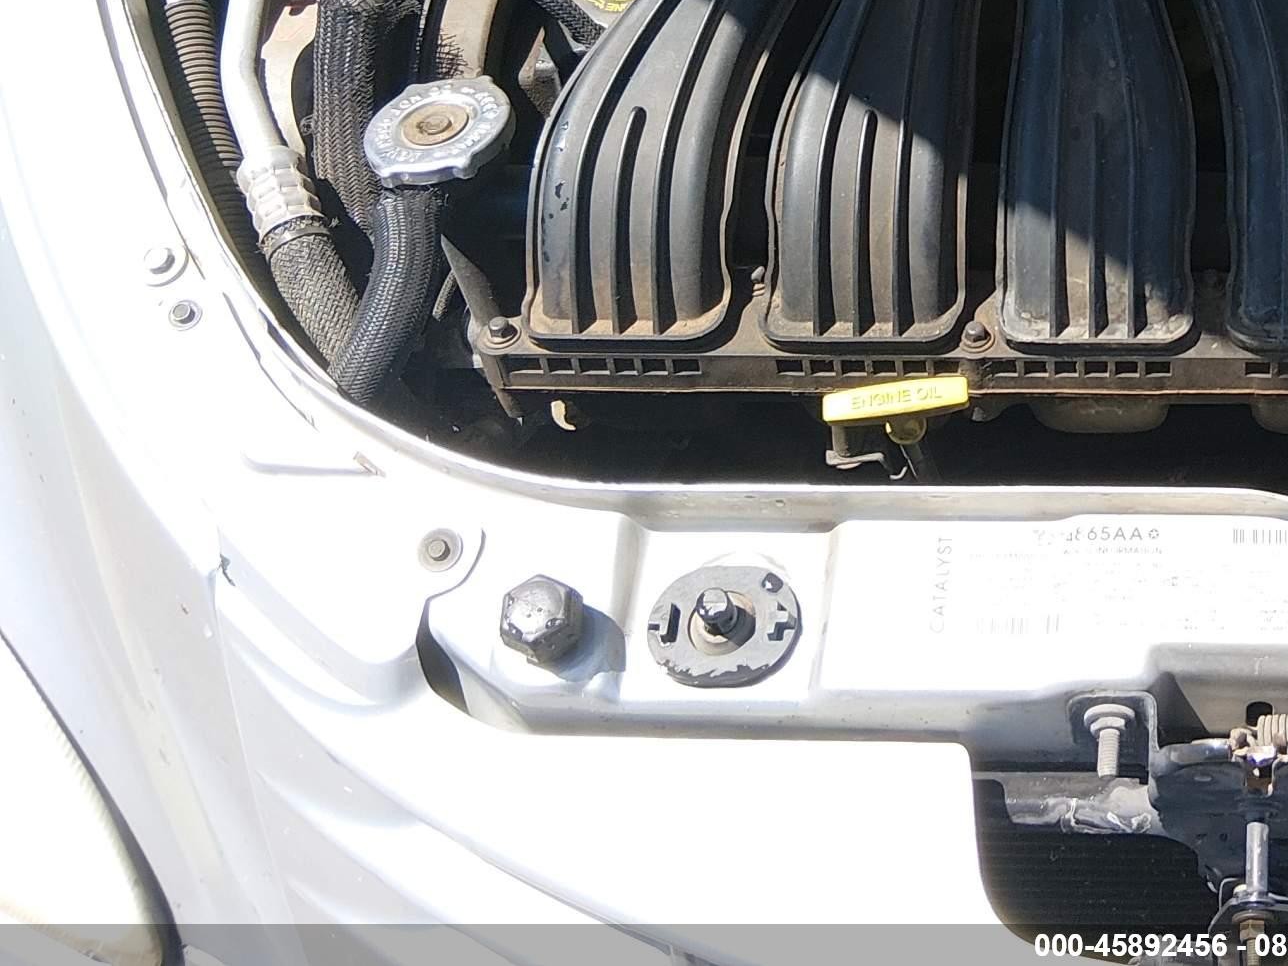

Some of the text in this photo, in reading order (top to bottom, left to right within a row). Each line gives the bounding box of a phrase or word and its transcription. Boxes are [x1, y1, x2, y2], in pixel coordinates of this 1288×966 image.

[850, 385, 943, 410] ENGINE OIL
[929, 537, 953, 634] CATALYST
